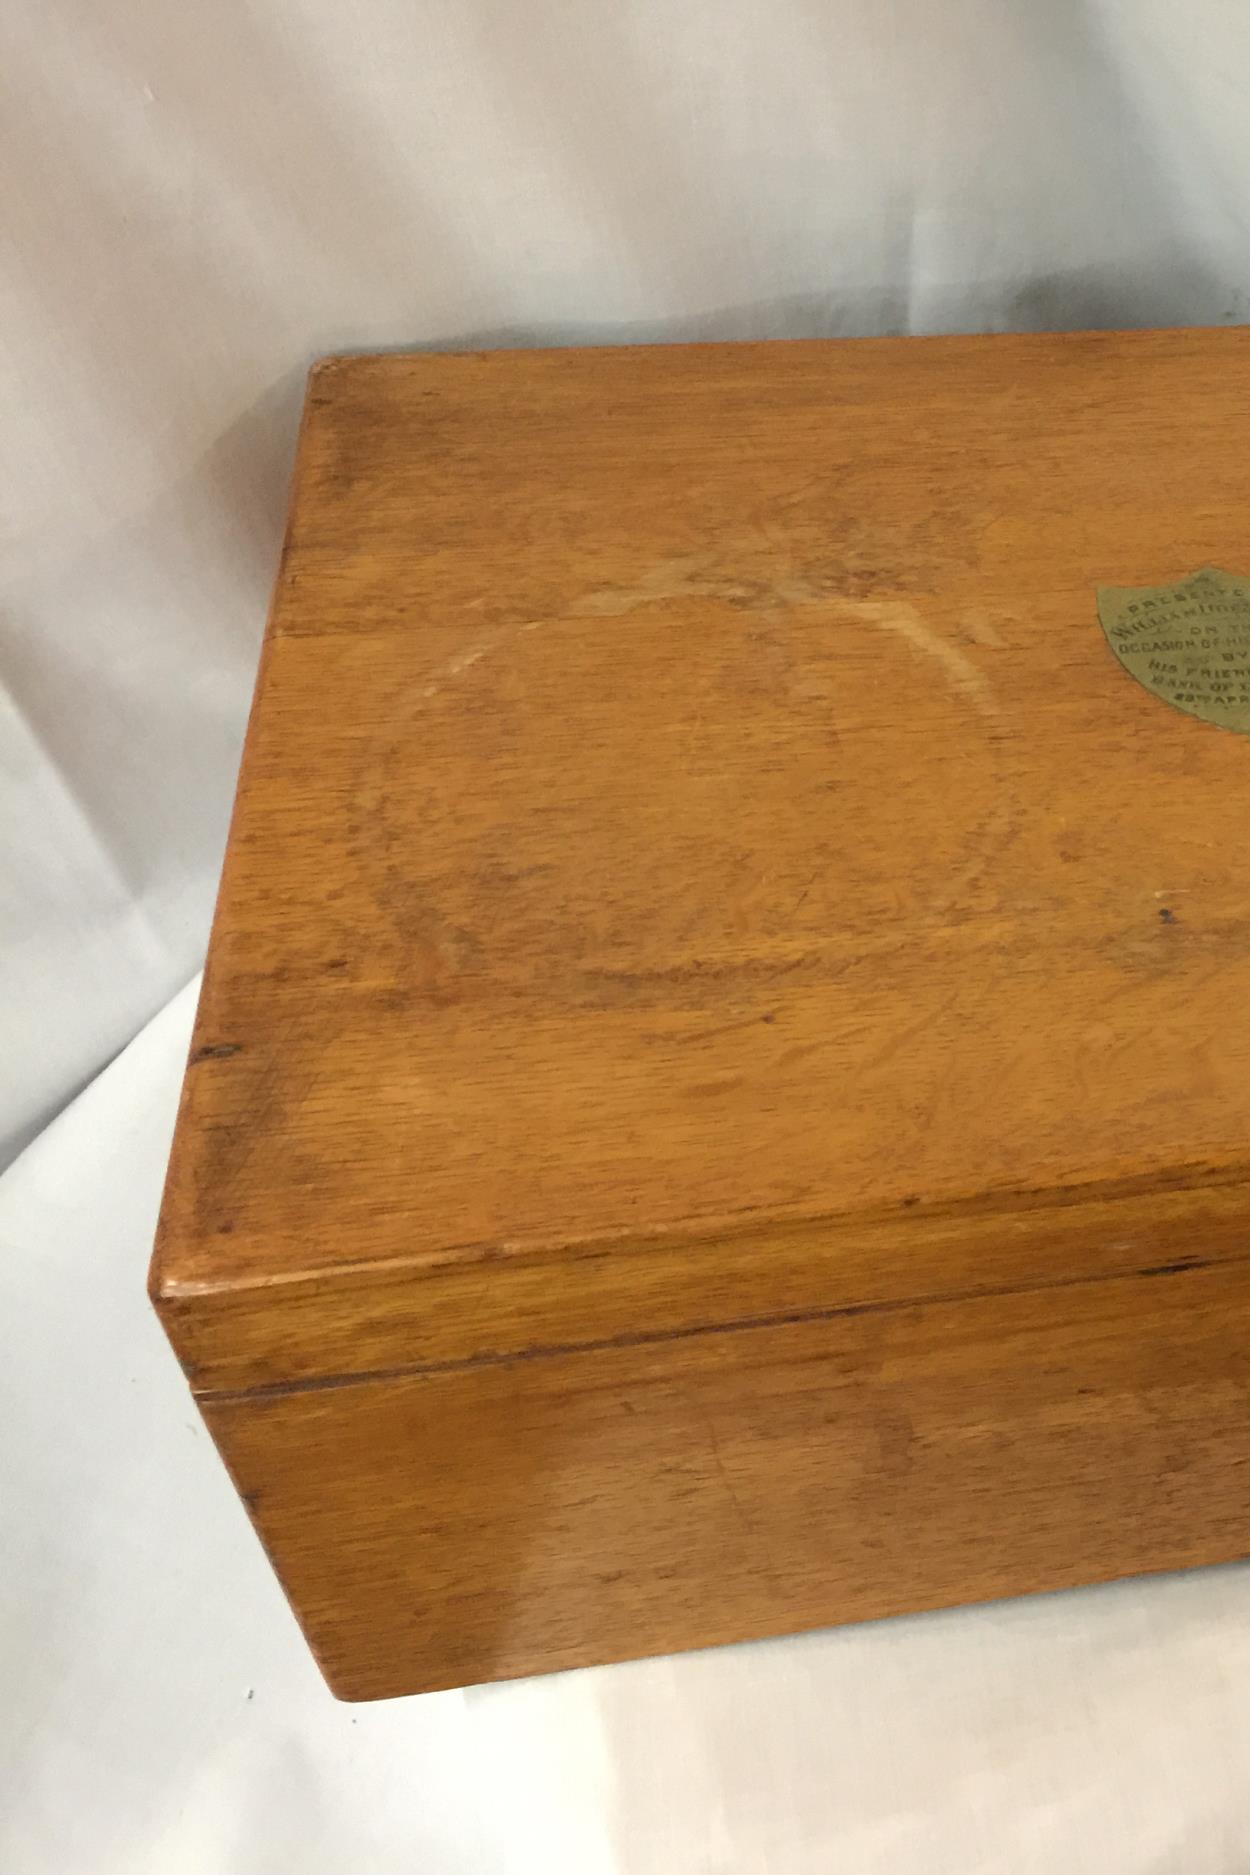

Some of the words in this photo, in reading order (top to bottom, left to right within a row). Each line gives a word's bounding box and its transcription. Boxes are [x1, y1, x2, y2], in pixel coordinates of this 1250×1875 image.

[1190, 626, 1217, 636] ON
[1119, 640, 1195, 654] OCCASION
[1201, 638, 1219, 649] OF
[1222, 651, 1248, 662] BY
[1148, 658, 1178, 673] HIS
[1210, 681, 1234, 692] OF
